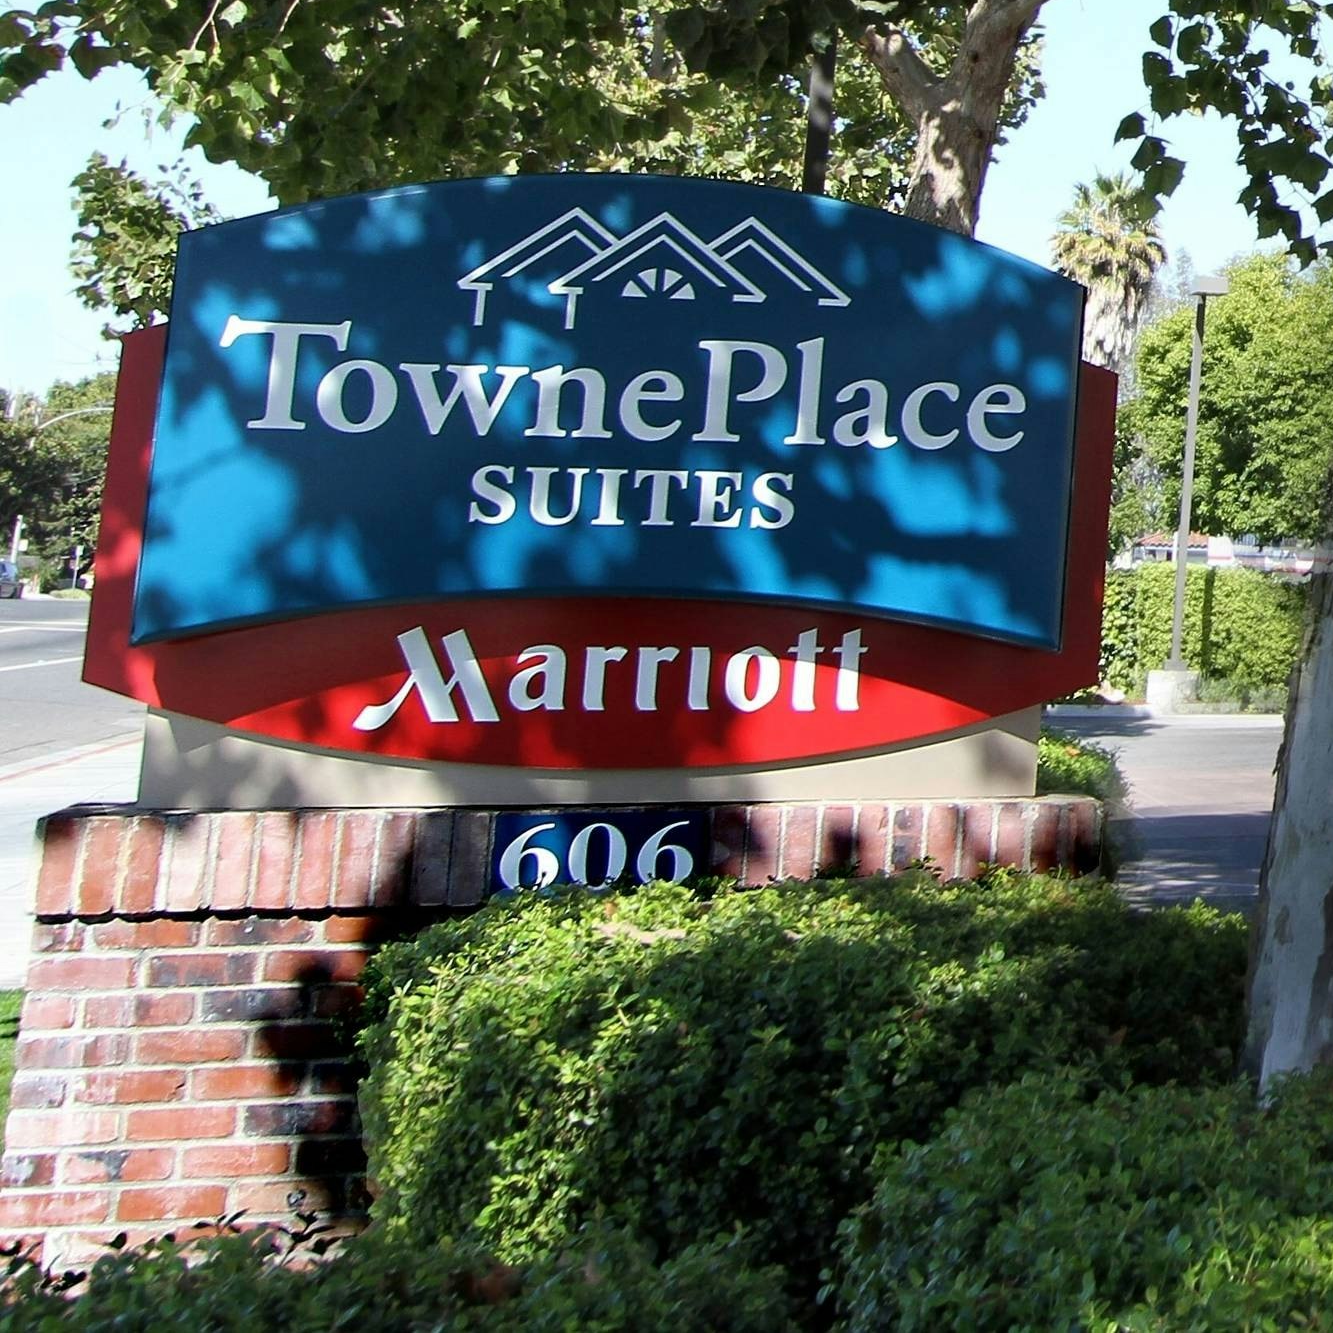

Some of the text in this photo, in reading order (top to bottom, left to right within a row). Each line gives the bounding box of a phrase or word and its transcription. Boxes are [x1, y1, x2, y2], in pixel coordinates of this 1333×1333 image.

[219, 314, 1027, 453] TownePlace
[468, 464, 797, 531] SUITES
[352, 626, 870, 731] Marriott
[499, 820, 694, 891] 606
